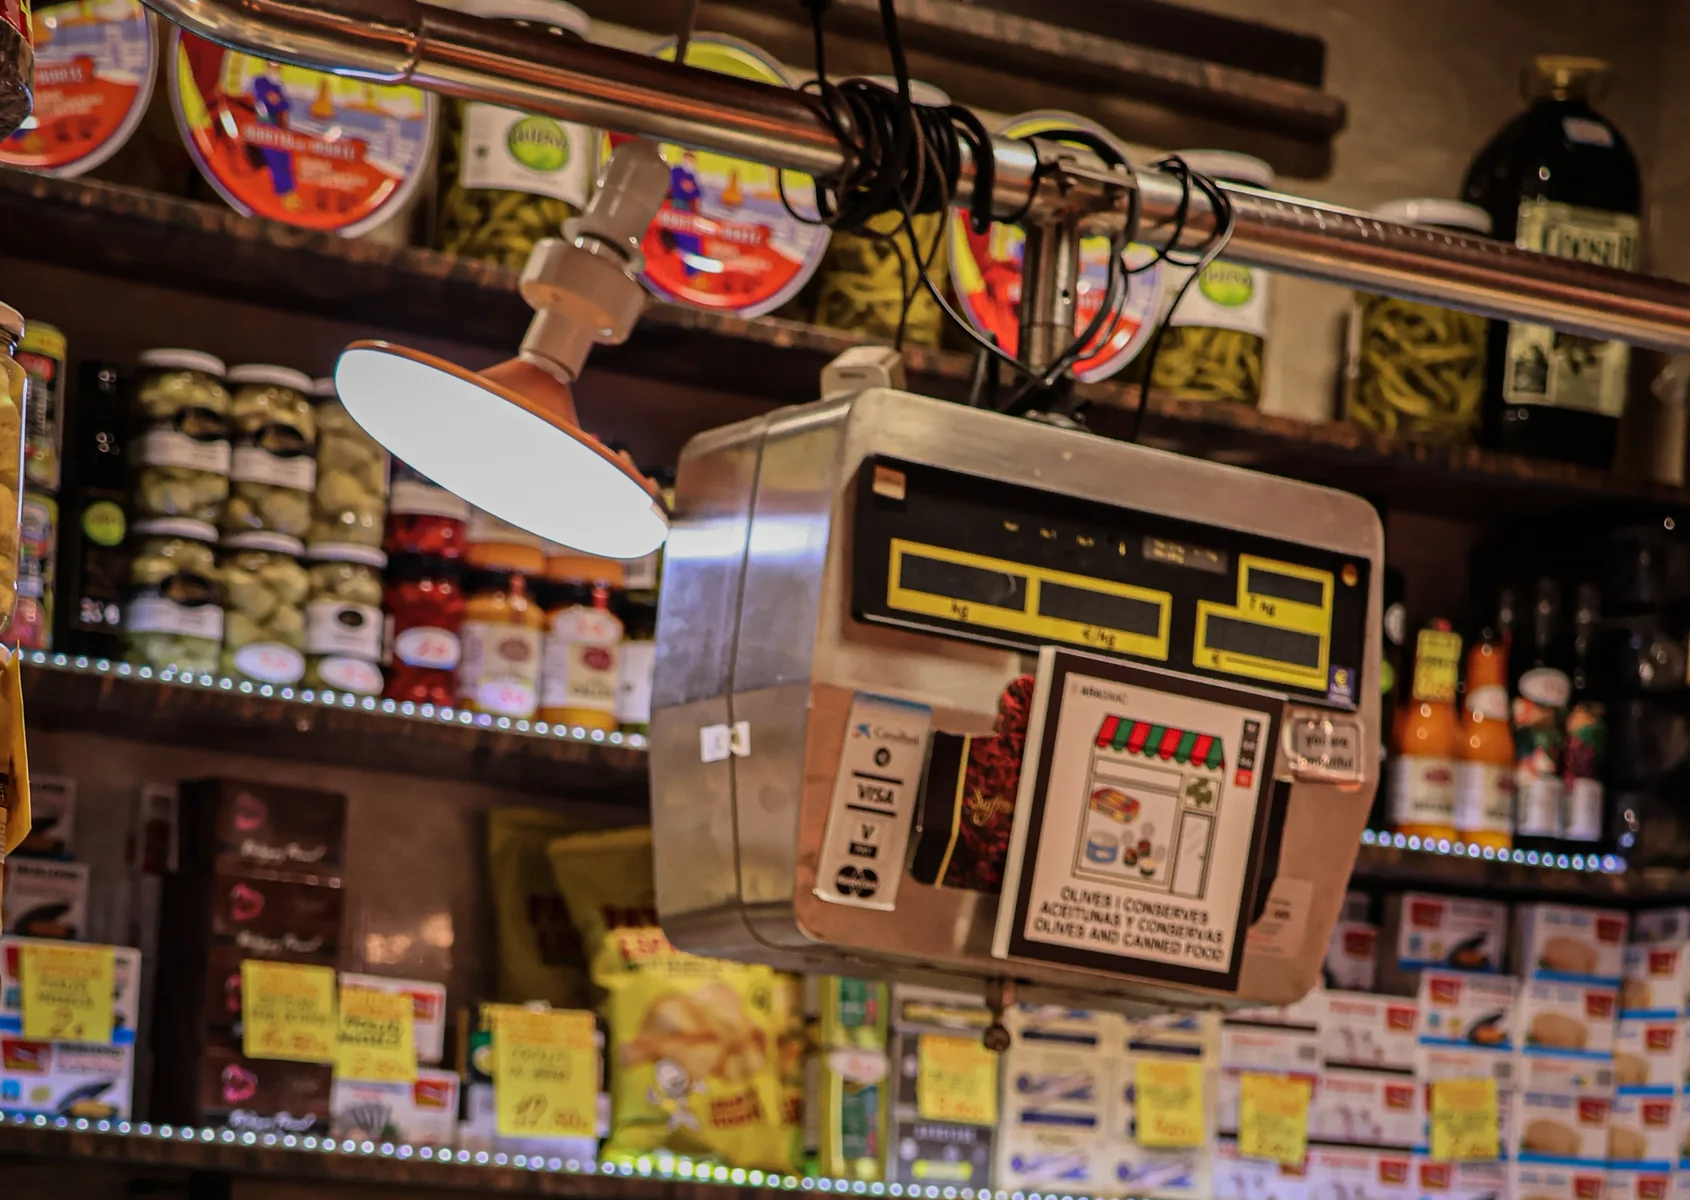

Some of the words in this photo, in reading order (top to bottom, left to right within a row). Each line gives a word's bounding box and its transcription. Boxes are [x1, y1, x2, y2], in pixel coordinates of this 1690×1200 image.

[857, 784, 894, 805] VISA
[1040, 900, 1122, 927] ACEITUNAS
[1124, 914, 1134, 928] Y
[1137, 917, 1225, 944] CONSERVAS
[1059, 885, 1113, 909] OLIVES
[1123, 896, 1210, 925] CONSERVES
[1033, 915, 1085, 939] OLIVES
[1089, 928, 1119, 944] AND
[1122, 931, 1182, 955] CANNED
[1185, 942, 1225, 962] FOOD
